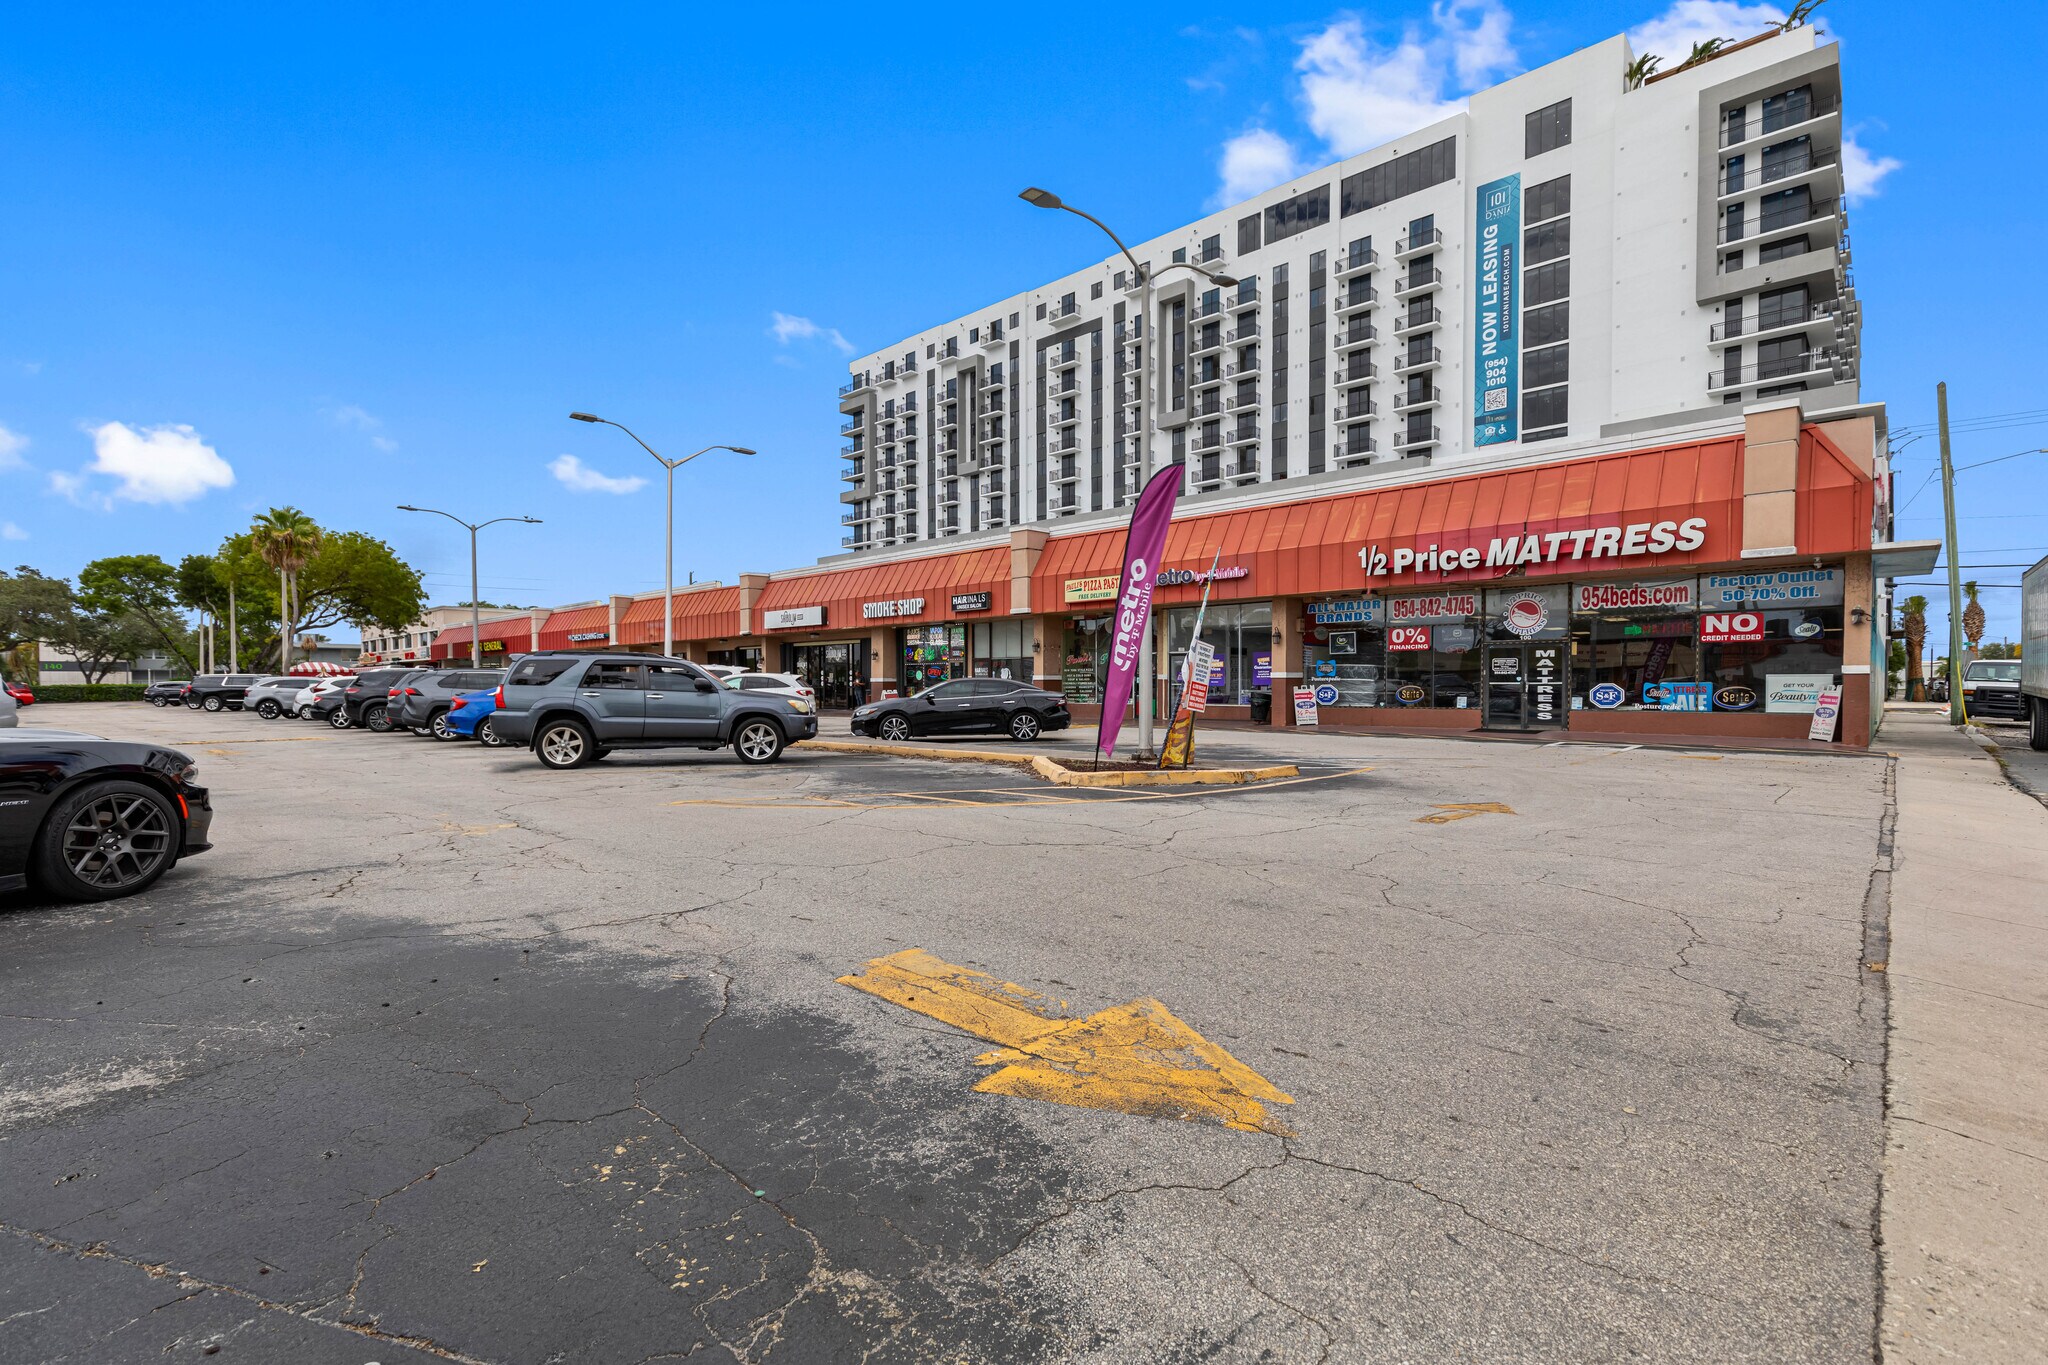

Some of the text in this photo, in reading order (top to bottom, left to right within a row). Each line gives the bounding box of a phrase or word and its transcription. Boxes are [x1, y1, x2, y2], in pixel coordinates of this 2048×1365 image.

[1491, 192, 1505, 206] 101
[1485, 206, 1511, 220] DANIA
[1482, 224, 1498, 356] NOW LEASING
[1485, 357, 1508, 369] (954)
[1486, 367, 1506, 378] 904
[1486, 376, 1506, 387] 1010
[1394, 544, 1480, 574] Price
[1485, 518, 1708, 567] MATTRESS
[1156, 568, 1194, 585] etro
[1710, 569, 1834, 588] Factory Outlet
[1084, 579, 1102, 591] PIZZA
[1516, 591, 1547, 606] PRICE
[1581, 583, 1689, 609] 954beds.com
[1721, 588, 1786, 602] 50-70%
[863, 597, 924, 619] SMOKE SHOP
[1307, 600, 1381, 614] ALL MAJOR
[1393, 595, 1474, 619] 954-842-4745
[1114, 559, 1147, 671] metro
[1127, 643, 1138, 658] by
[1136, 582, 1151, 626] Mobile
[1316, 611, 1373, 624] BRANDS
[1503, 617, 1547, 635] MATTRESS
[1705, 614, 1758, 633] NO
[1391, 628, 1426, 644] 0%
[1797, 625, 1818, 637] Sealy
[484, 640, 502, 651] GENERAL
[928, 667, 941, 676] OPEN
[1535, 649, 1556, 720] MATTRESS
[1319, 691, 1334, 699] S&F
[1595, 691, 1617, 700] S&F
[1634, 703, 1681, 711] Posturepedic
[1674, 694, 1707, 711] ALE
